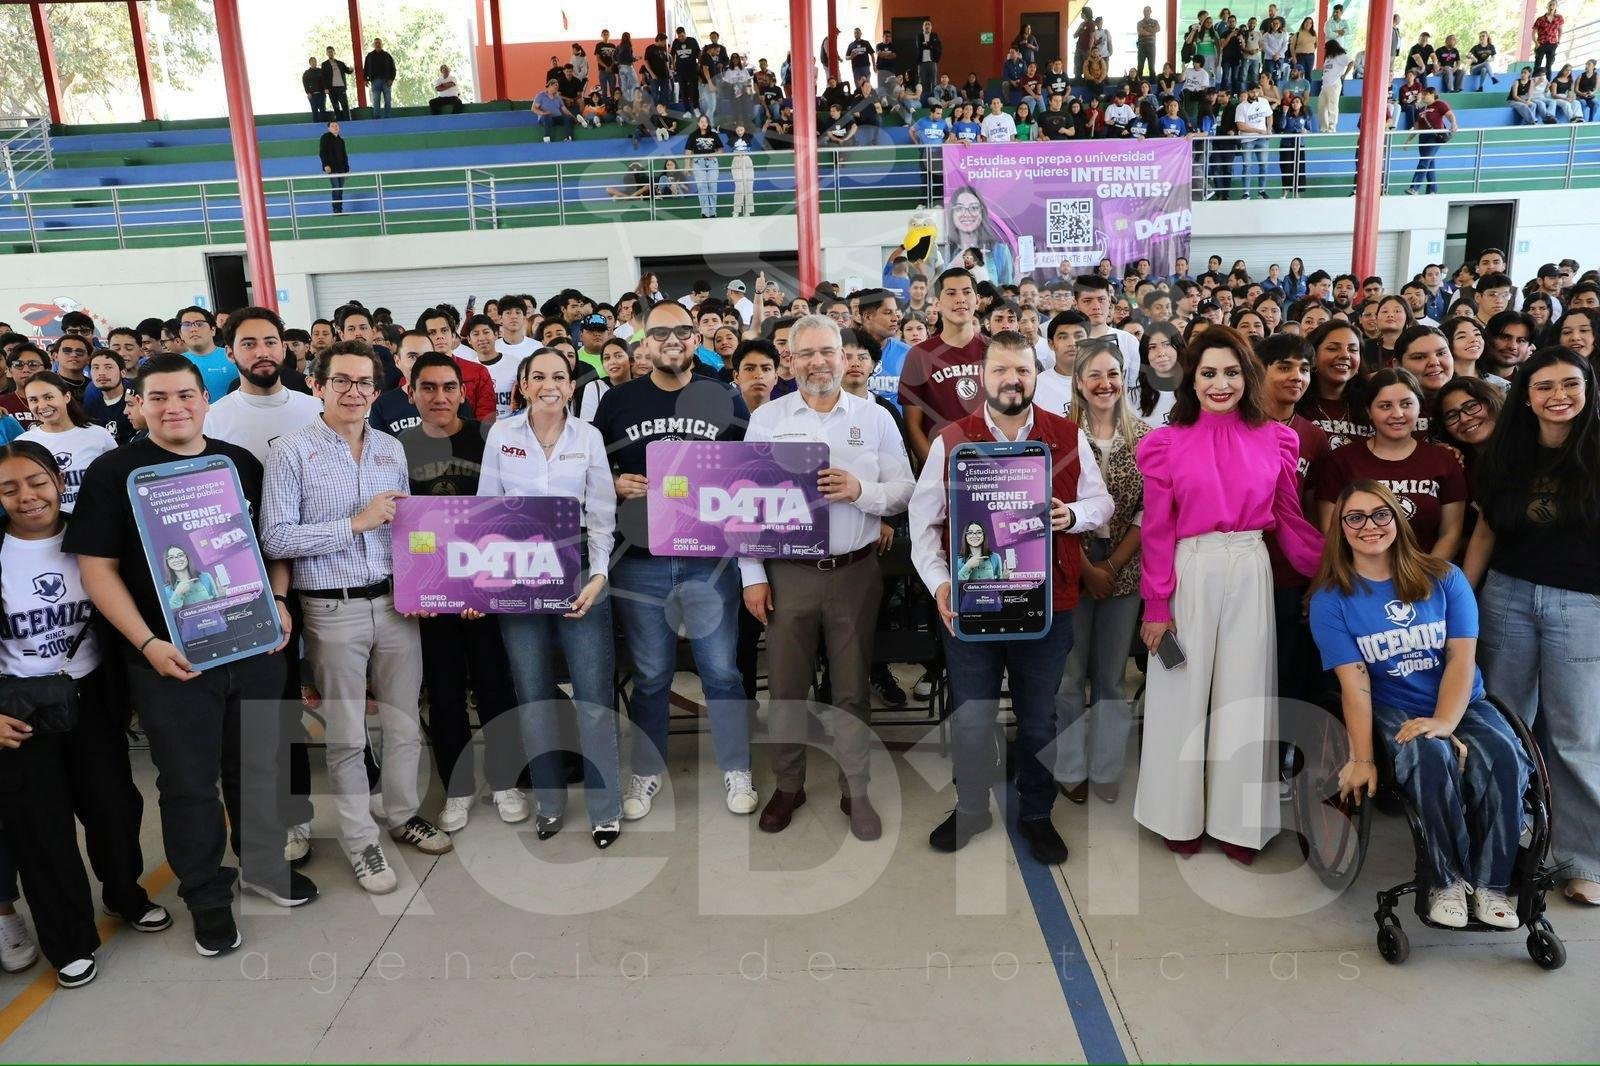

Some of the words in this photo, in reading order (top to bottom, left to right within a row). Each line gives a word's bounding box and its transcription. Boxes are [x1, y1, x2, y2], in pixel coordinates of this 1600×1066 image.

[960, 155, 1017, 170] ¿Estudias
[1019, 156, 1034, 165] en
[1036, 153, 1073, 167] prepa
[1075, 154, 1082, 163] o
[1085, 150, 1155, 163] universidad
[968, 166, 1013, 181] pública
[1015, 169, 1022, 181] y
[1024, 166, 1069, 179] quieres
[1071, 165, 1162, 183] INTERNET
[1096, 182, 1172, 199] GRATIS?
[965, 474, 1006, 482] universidad
[1007, 473, 1034, 482] pública
[966, 468, 998, 477] ¿Estudias
[1009, 468, 1031, 476] prepa
[149, 486, 185, 501] ¿Estudias
[186, 485, 196, 493] en
[197, 481, 220, 492] prepa
[150, 492, 196, 507] universidad
[197, 488, 224, 499] pública
[971, 491, 1028, 501] INTERNET
[160, 502, 190, 514] quieres
[987, 501, 1035, 511] GRATIS?
[162, 504, 222, 525] INTERNET
[182, 513, 232, 531] GRATIS?
[45, 630, 67, 640] SINCE
[1402, 651, 1423, 660] SINCE
